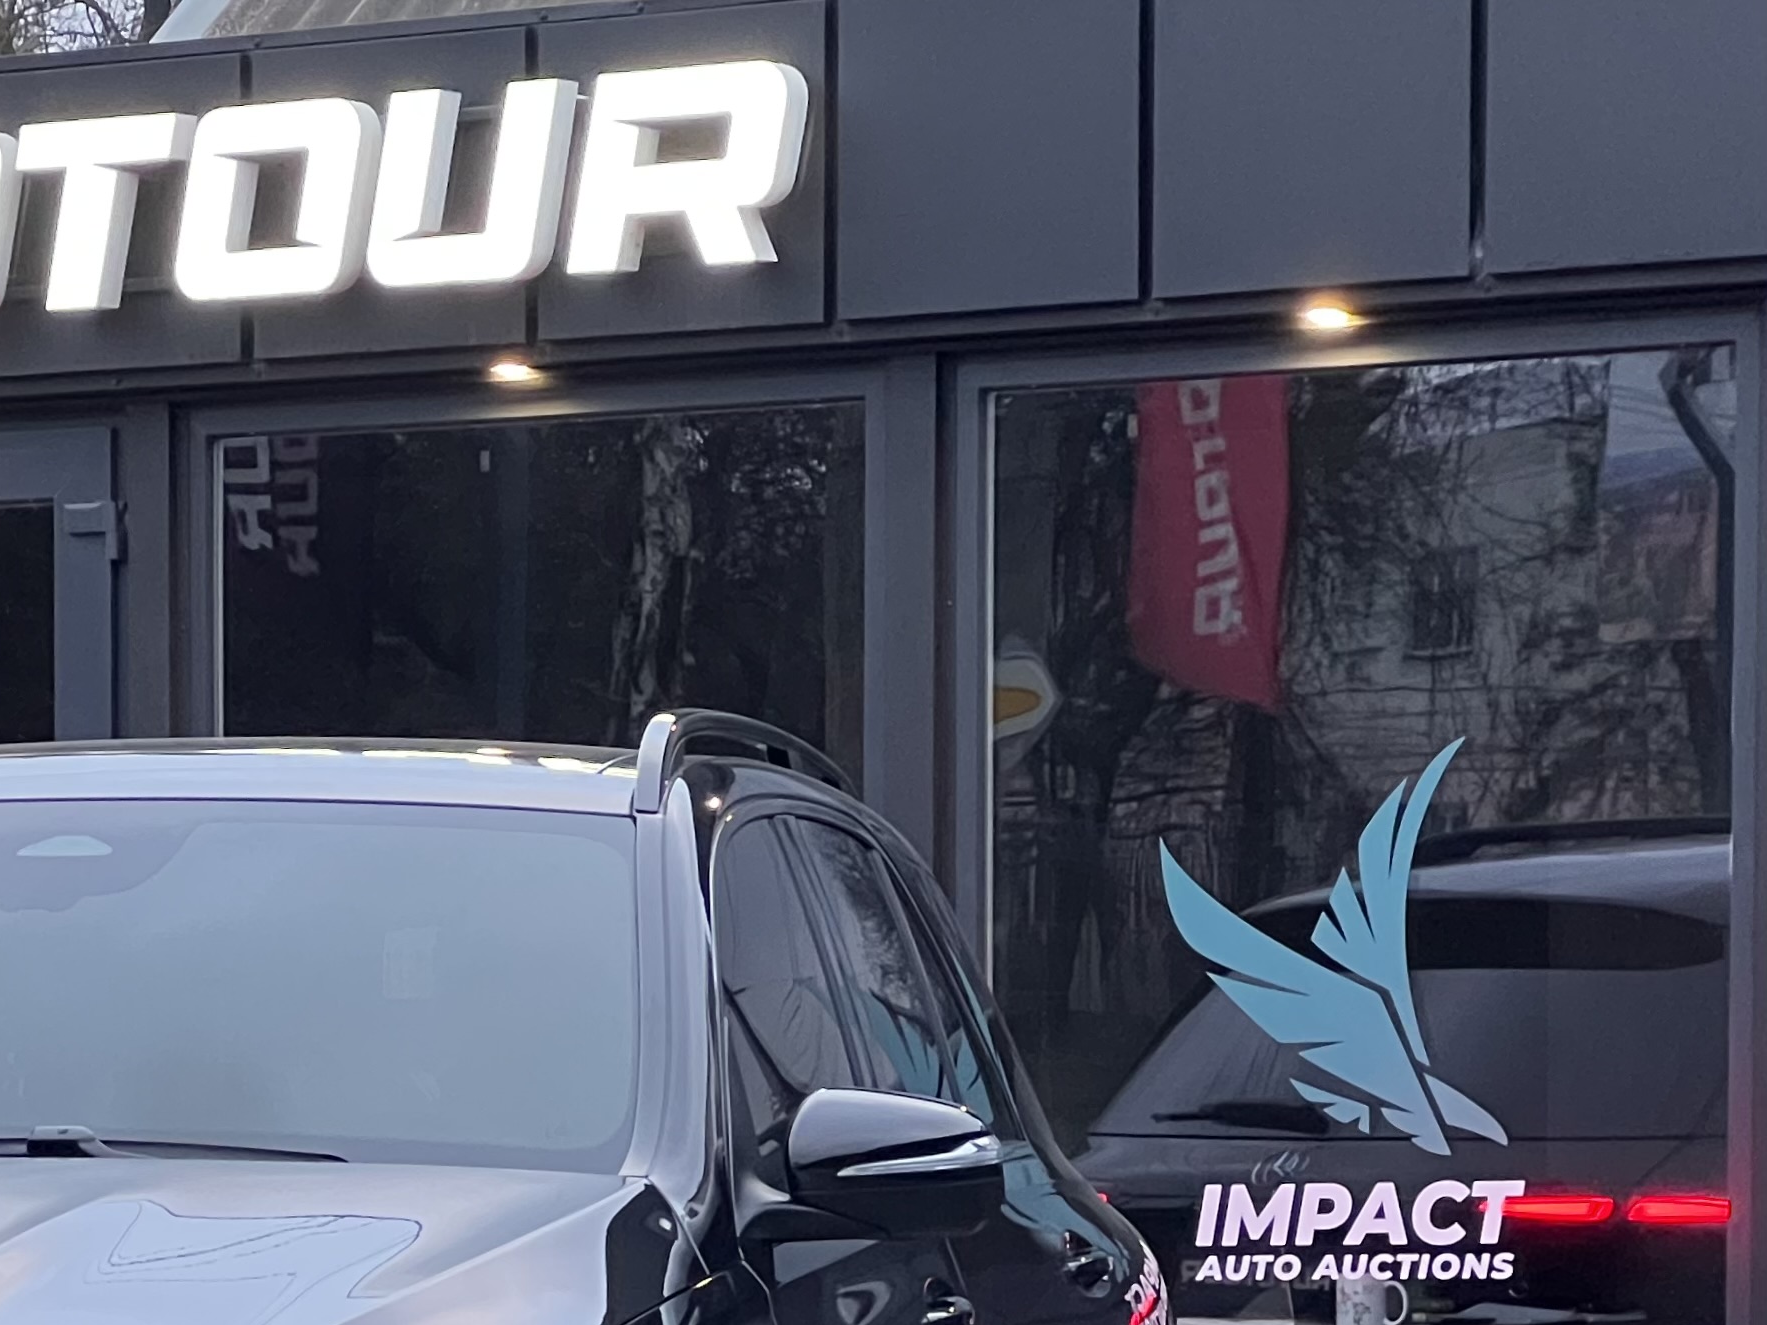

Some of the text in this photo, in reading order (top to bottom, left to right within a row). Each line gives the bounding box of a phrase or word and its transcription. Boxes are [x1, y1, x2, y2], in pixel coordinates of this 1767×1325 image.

[1195, 1179, 1526, 1247] IMPACT
[1195, 1255, 1302, 1282] AUTO
[1311, 1252, 1515, 1281] AUCTIONS
